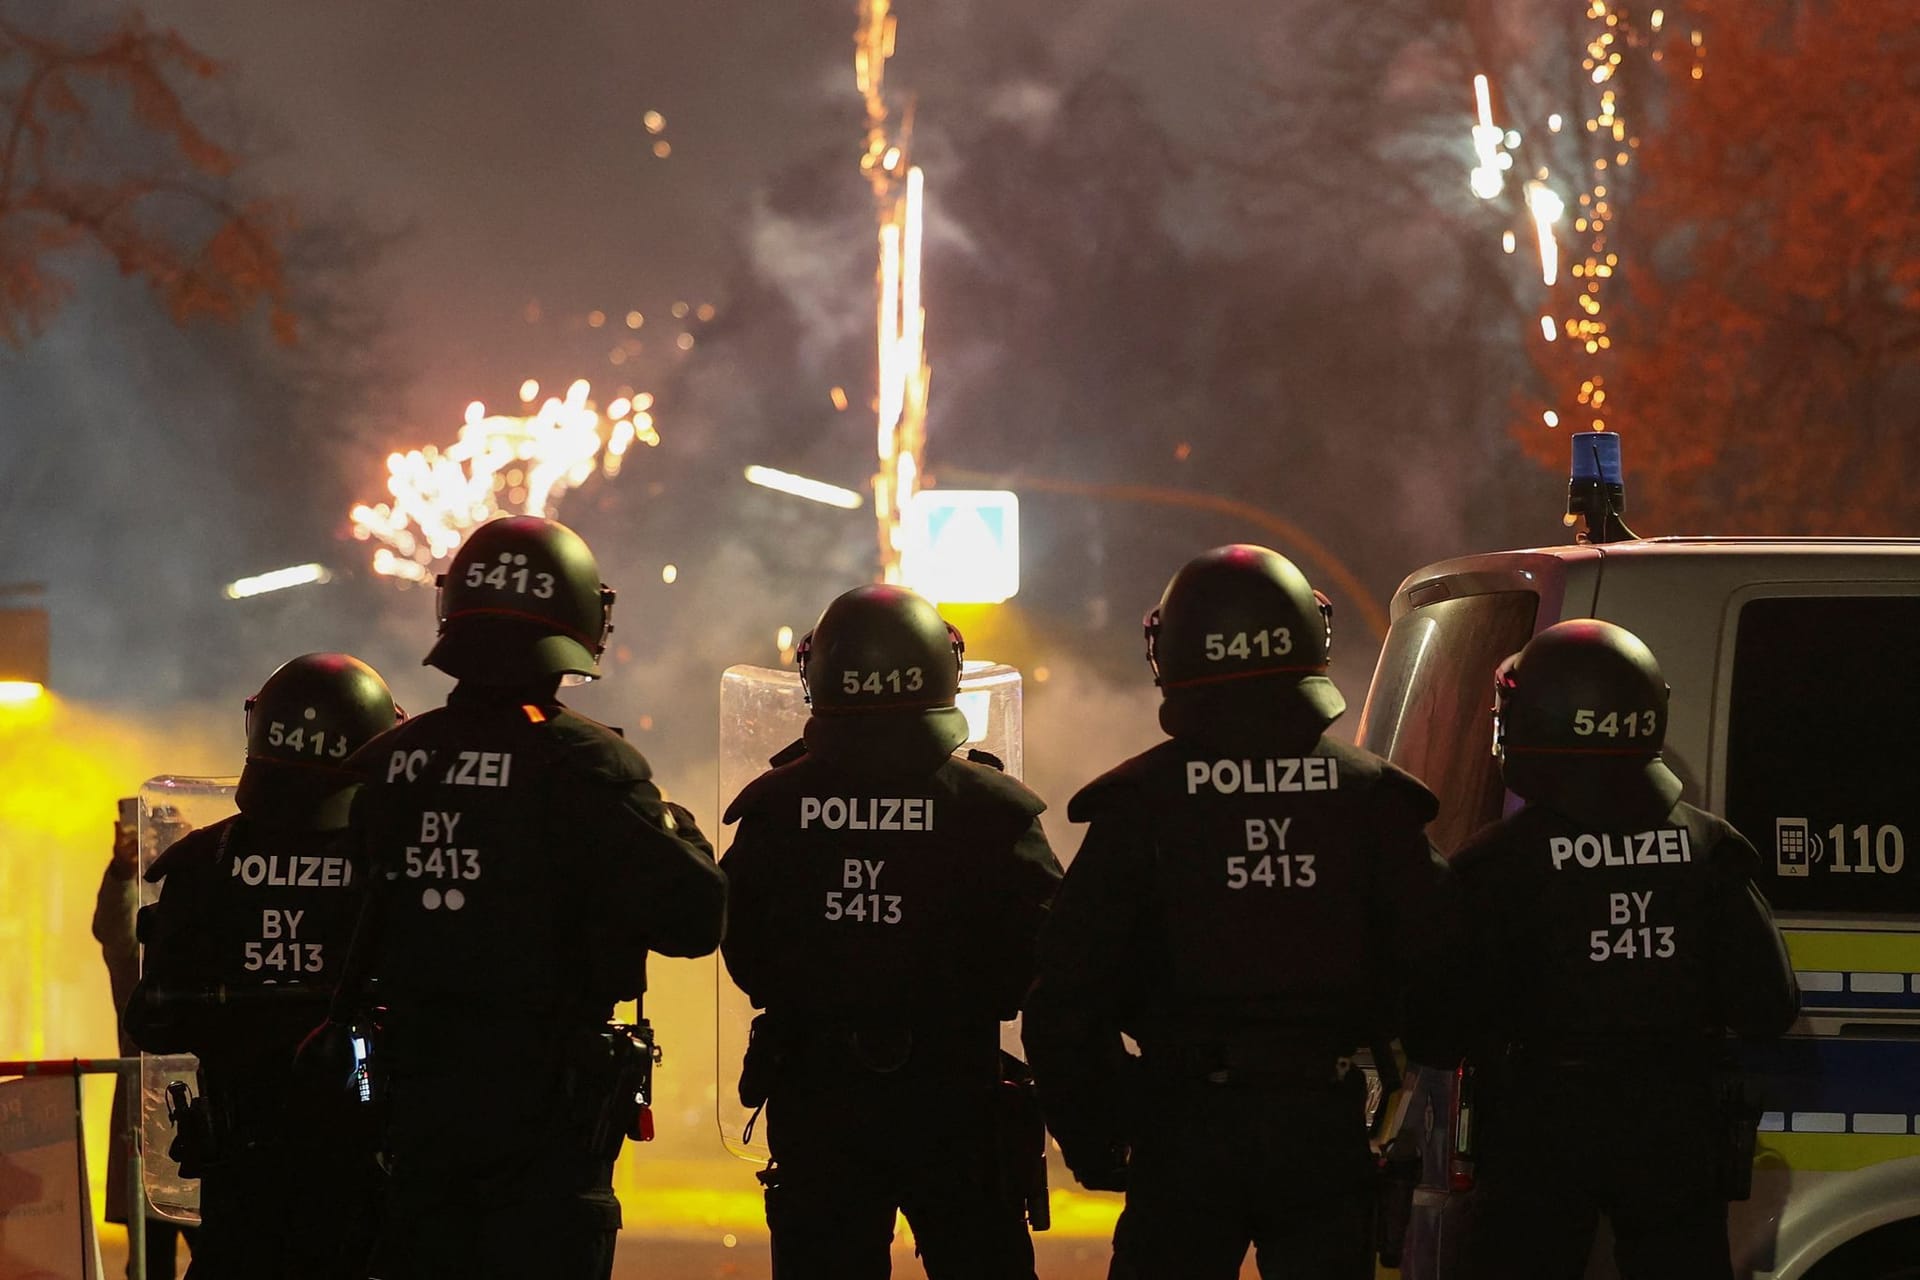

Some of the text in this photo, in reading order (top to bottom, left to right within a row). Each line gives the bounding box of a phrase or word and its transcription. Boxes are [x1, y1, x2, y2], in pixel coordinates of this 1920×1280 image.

[466, 563, 556, 599] 5413
[1205, 627, 1293, 661] 5413
[843, 667, 924, 695] 5413
[1573, 708, 1656, 738] 5413
[386, 749, 512, 787] POZEI
[1186, 757, 1339, 795] POLIZEI
[420, 811, 461, 844] BY
[800, 796, 934, 831] POLIZEI
[1245, 817, 1292, 852] BY
[1549, 828, 1692, 870] POLIZEI
[1828, 823, 1905, 874] 110
[405, 846, 481, 881] 5413
[843, 858, 885, 891] BY
[1226, 854, 1317, 889] 5413
[262, 909, 305, 940] BY
[824, 891, 902, 924] 5413
[1609, 890, 1653, 925] BY
[243, 941, 324, 973] 5413
[1589, 926, 1676, 962] 5413
